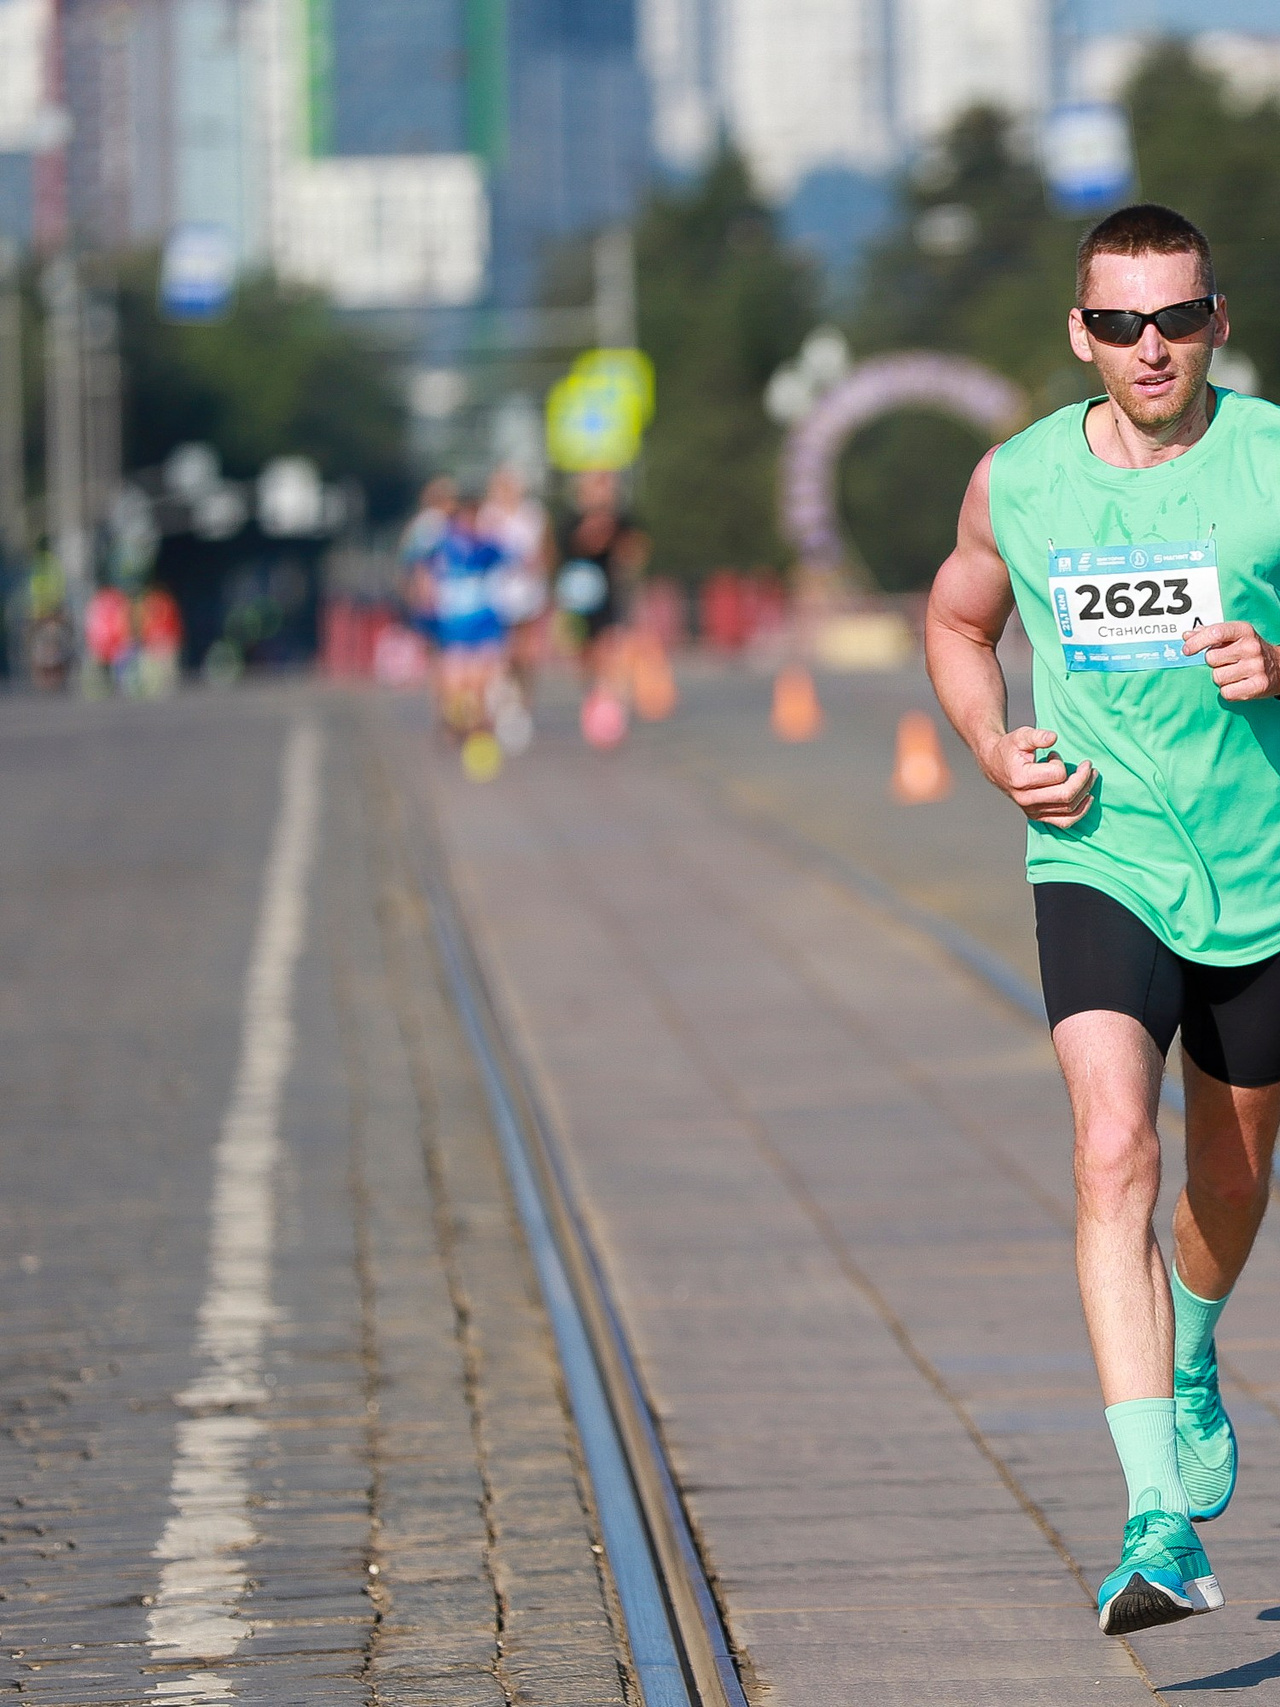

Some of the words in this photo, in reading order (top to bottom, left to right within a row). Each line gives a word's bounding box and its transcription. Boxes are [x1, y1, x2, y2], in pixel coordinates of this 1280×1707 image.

[1075, 578, 1192, 620] 2623
[1060, 613, 1071, 631] 21,1
[1098, 623, 1177, 638] Станислав
